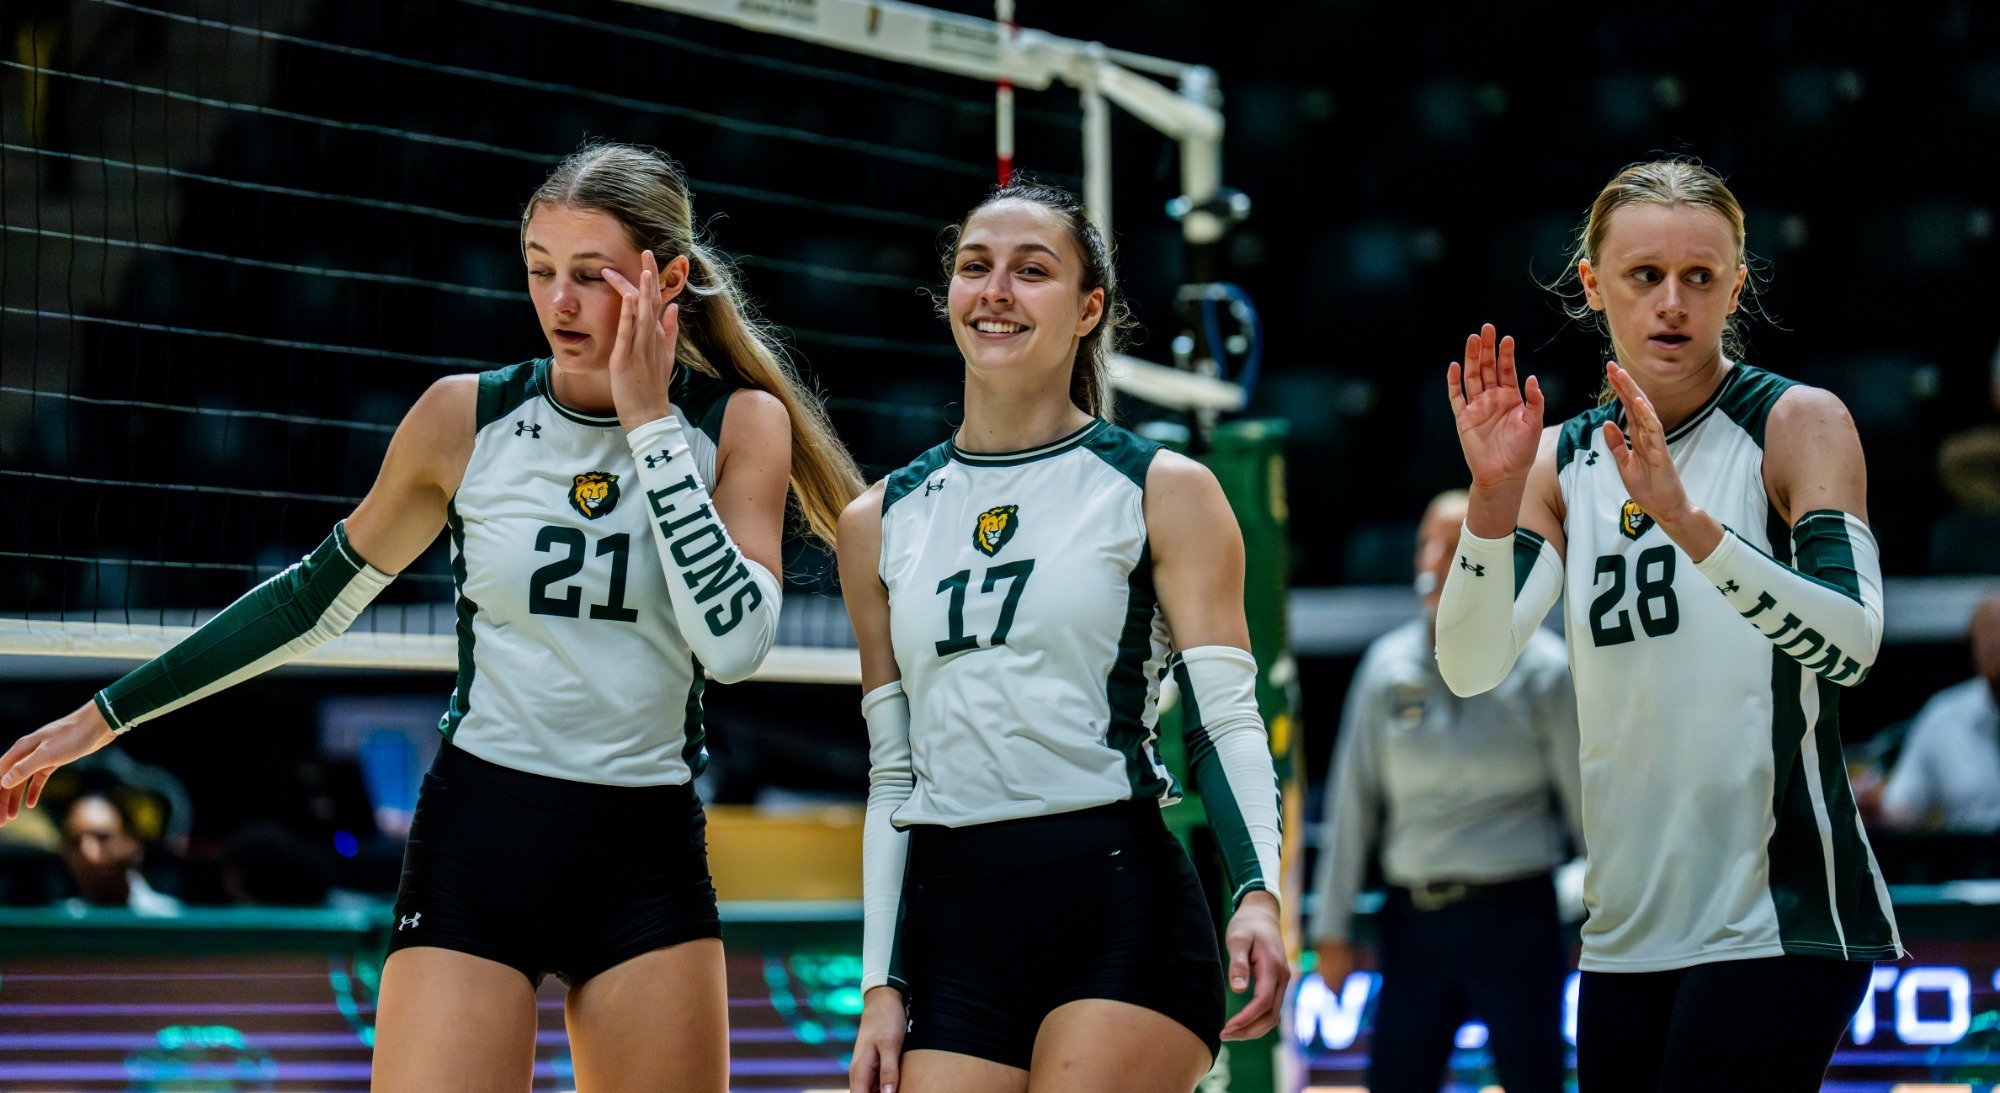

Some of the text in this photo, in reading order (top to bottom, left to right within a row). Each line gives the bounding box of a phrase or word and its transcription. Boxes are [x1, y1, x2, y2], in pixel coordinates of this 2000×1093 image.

[529, 525, 639, 623] 21
[646, 474, 763, 637] LIONS
[1589, 544, 1680, 648] 28
[935, 558, 1036, 657] 17
[1740, 590, 1872, 688] LION
